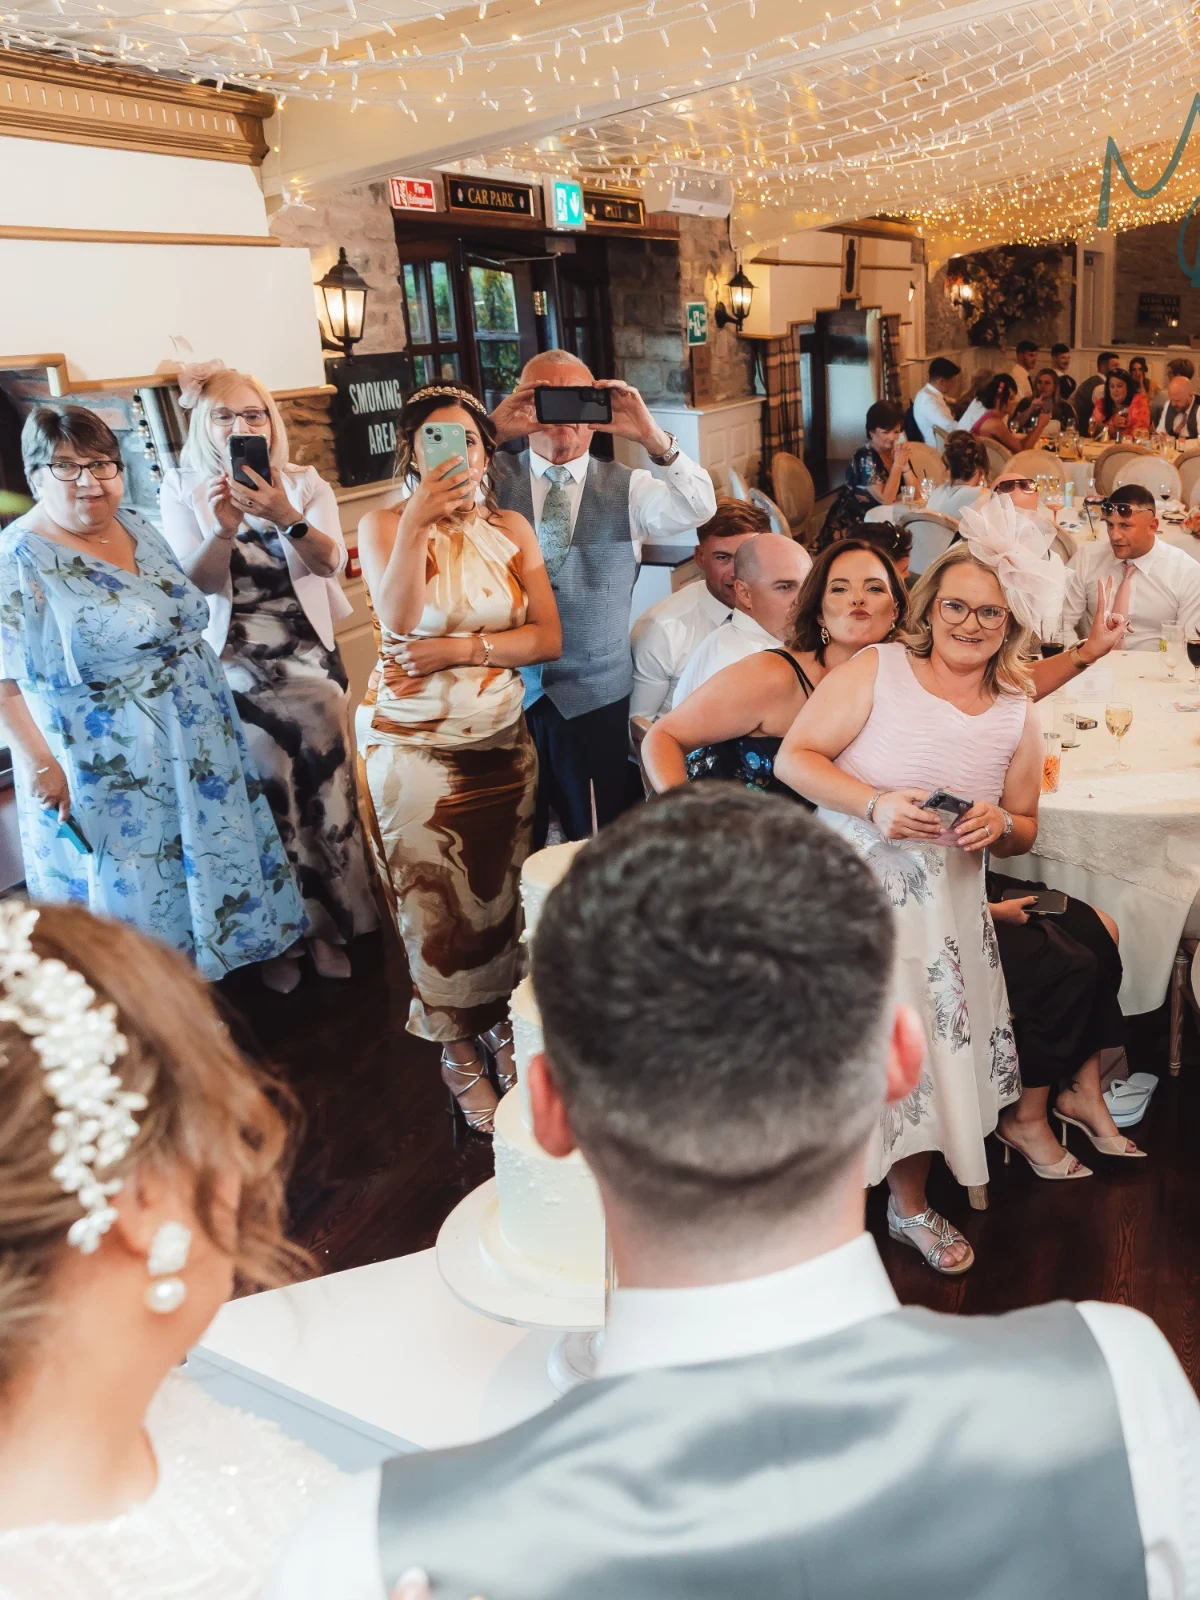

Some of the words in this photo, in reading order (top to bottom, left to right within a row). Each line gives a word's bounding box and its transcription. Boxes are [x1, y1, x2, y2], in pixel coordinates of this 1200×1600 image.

[467, 187, 489, 204] CAR
[490, 189, 515, 208] PARK
[348, 379, 403, 415] SMOKING
[368, 421, 397, 455] AREA
